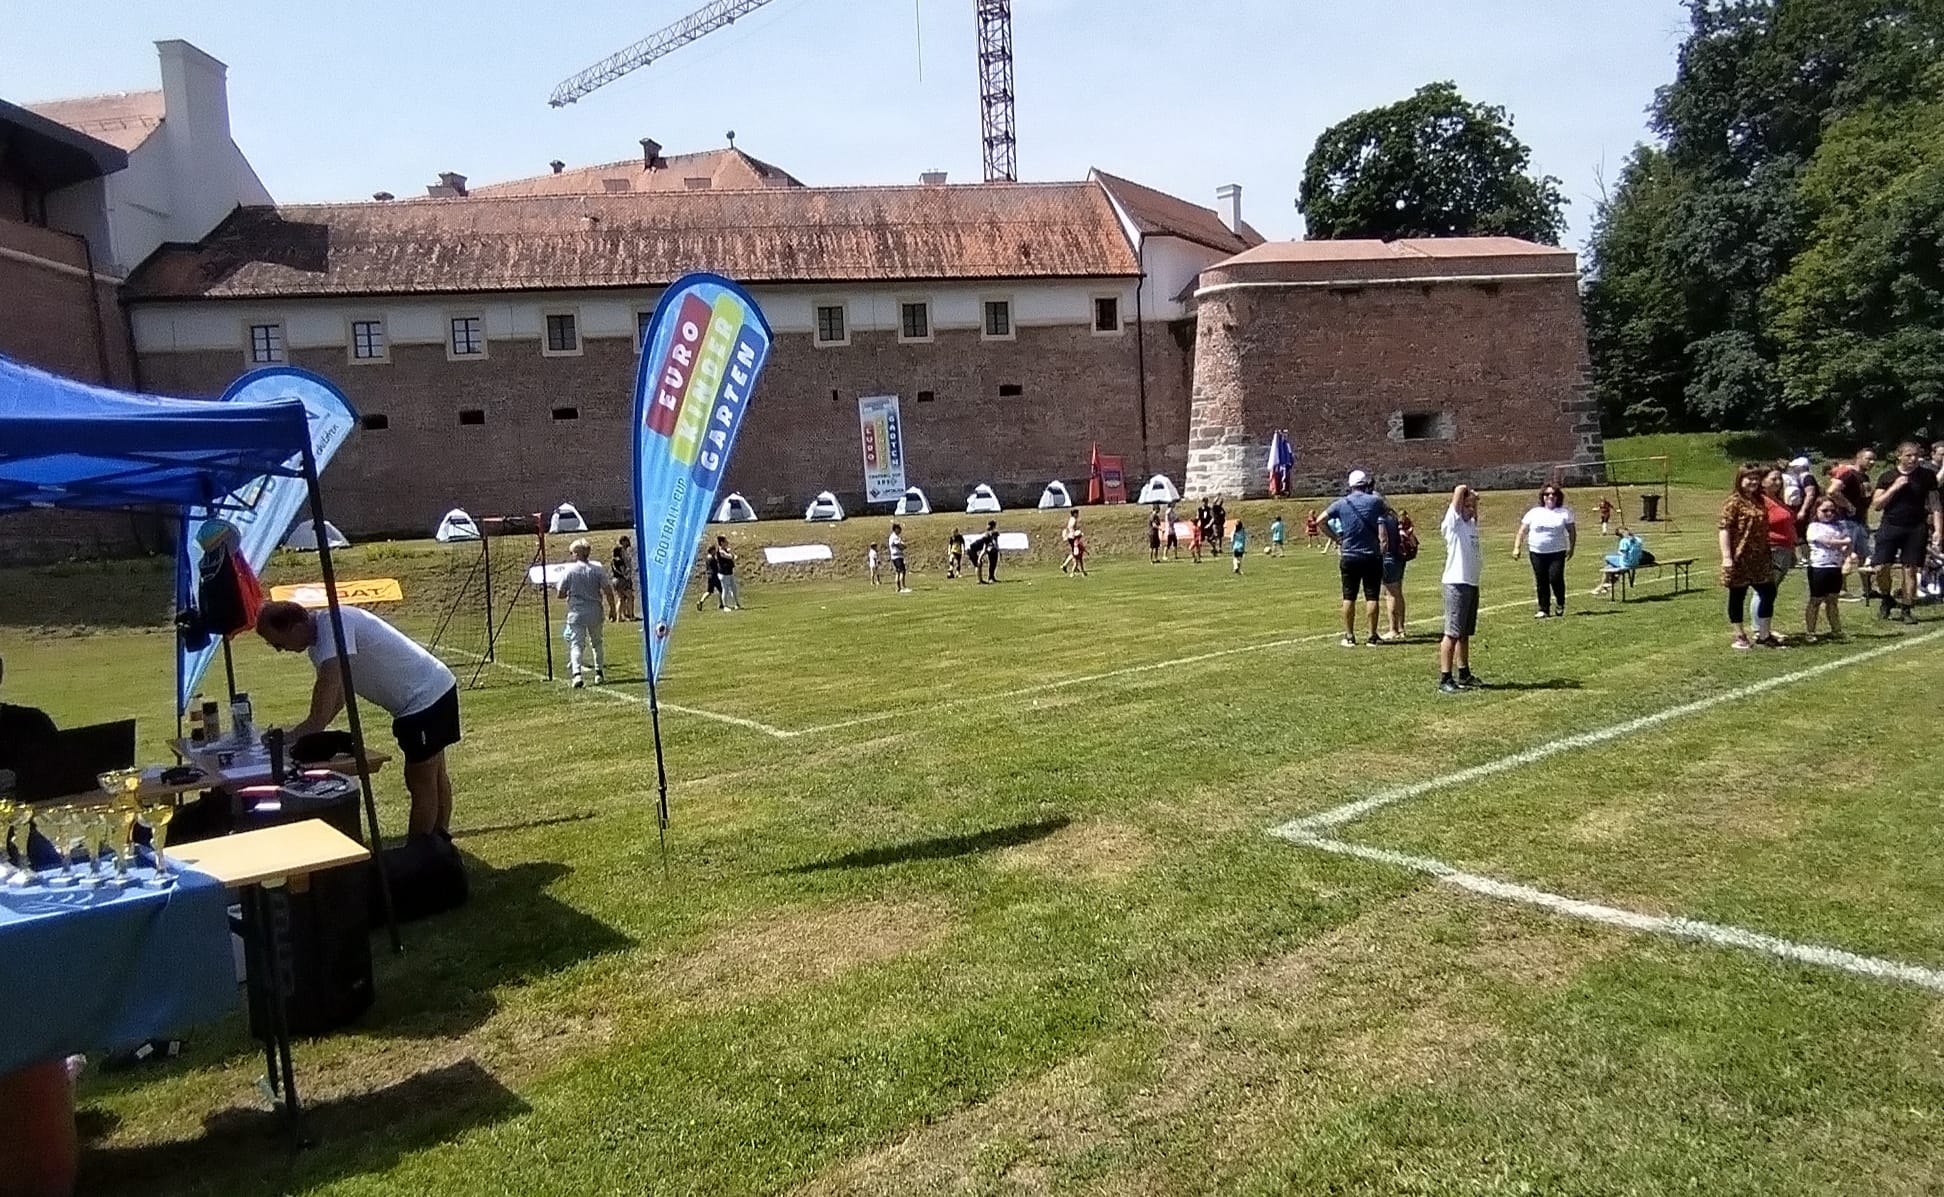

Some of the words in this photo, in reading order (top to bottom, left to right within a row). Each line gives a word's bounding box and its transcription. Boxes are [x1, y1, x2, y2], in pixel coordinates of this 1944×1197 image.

[658, 320, 699, 411] EURO
[678, 316, 734, 443] KINDER
[701, 341, 755, 471] GARTEN
[673, 477, 687, 502] CUP
